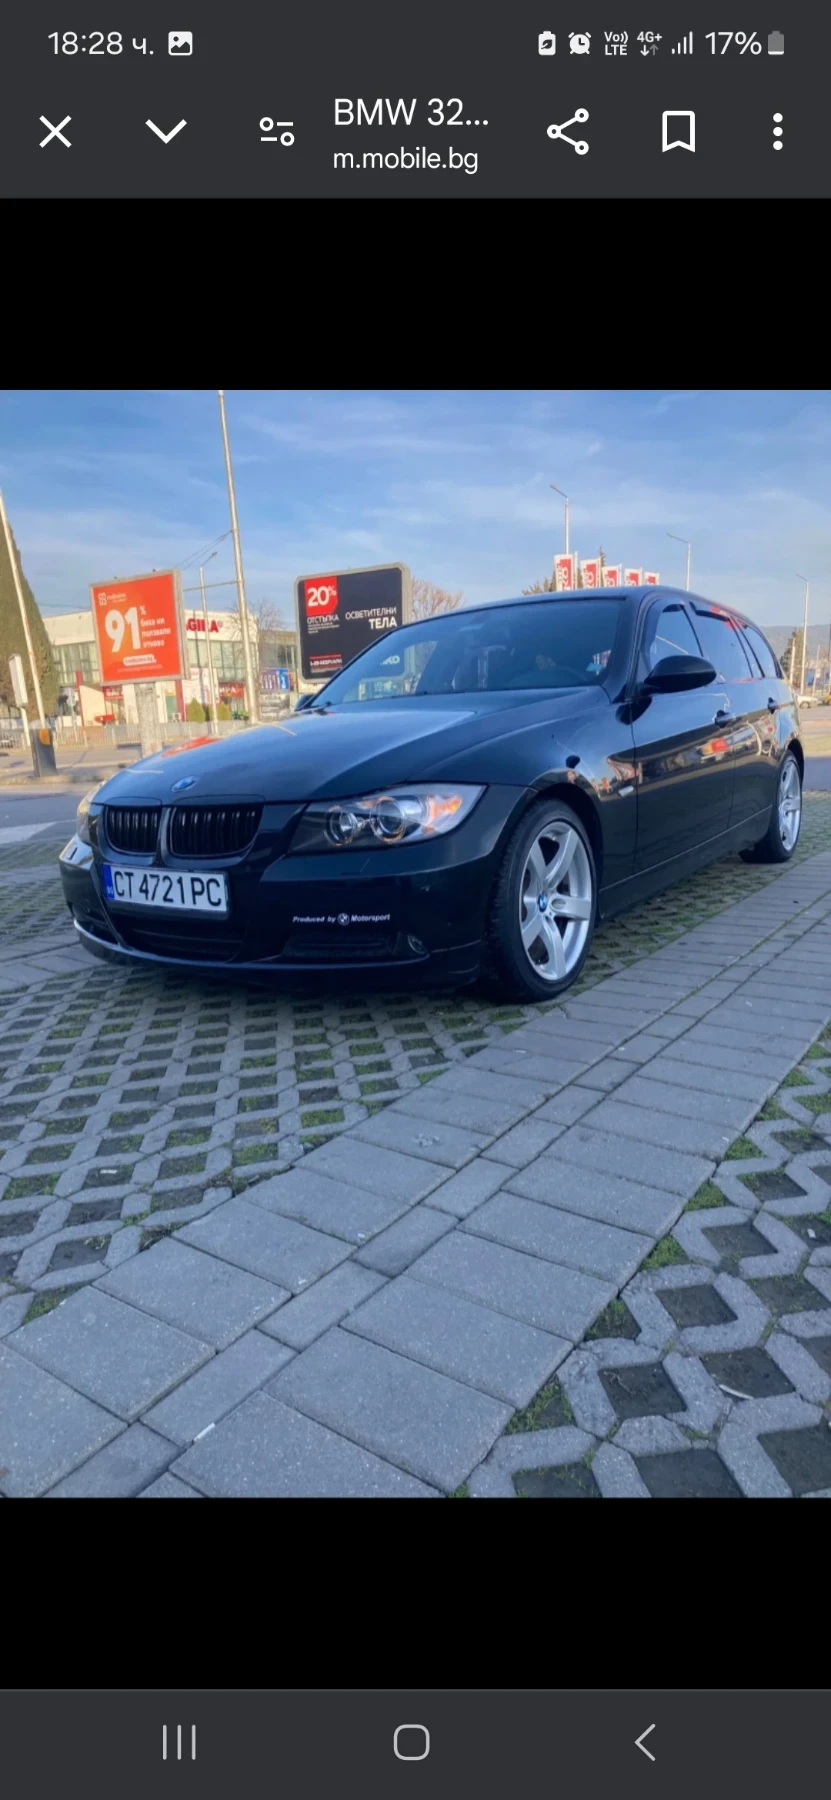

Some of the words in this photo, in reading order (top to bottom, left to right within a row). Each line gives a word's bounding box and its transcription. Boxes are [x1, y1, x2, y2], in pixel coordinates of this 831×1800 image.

[307, 586, 337, 607] 20%
[306, 614, 340, 624] ОТСТЪПКА
[345, 606, 397, 620] ОСВЕТИТЕЛНИ
[368, 616, 397, 630] ТЕЛА
[351, 914, 391, 923] Motorsport
